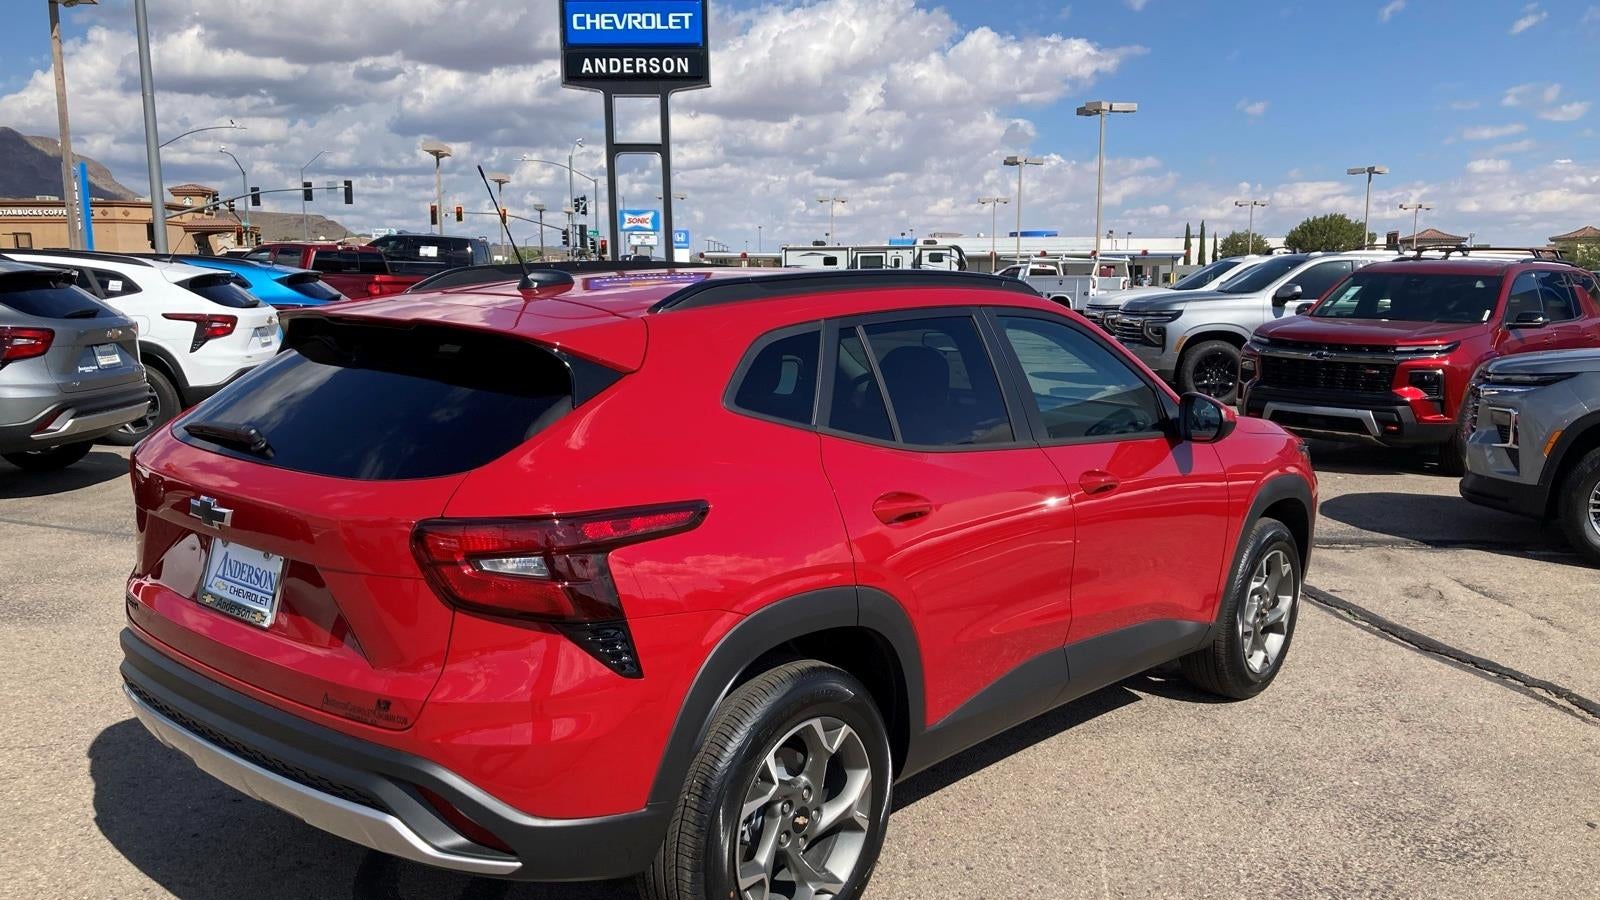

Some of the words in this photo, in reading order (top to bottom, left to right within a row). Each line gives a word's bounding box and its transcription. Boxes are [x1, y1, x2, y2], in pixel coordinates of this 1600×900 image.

[572, 13, 693, 30] CHEVROLET
[581, 57, 689, 74] ANDERSON
[208, 551, 276, 591] ANDERSON
[229, 585, 269, 607] CHEVROLET
[215, 599, 251, 619] Anderson
